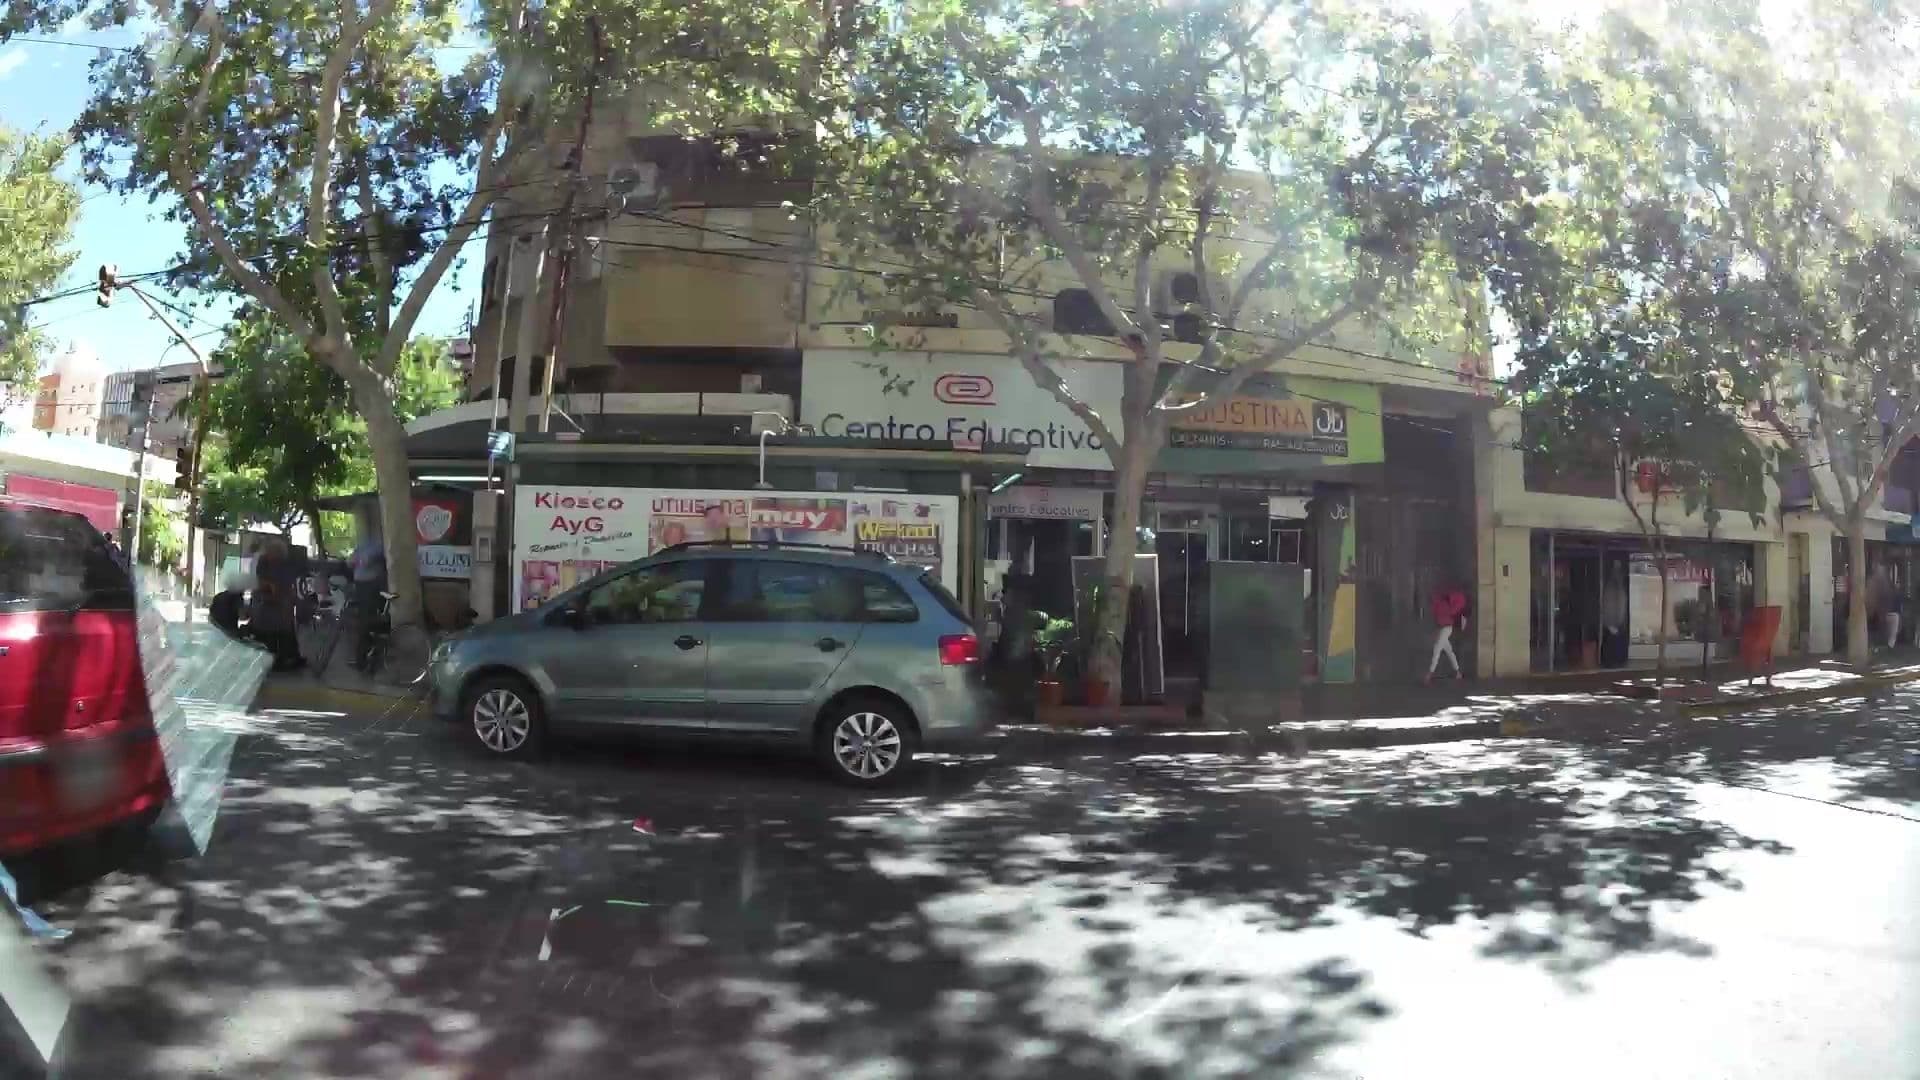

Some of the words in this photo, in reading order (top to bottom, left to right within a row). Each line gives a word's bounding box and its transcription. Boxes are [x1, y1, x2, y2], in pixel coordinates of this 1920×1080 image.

[821, 413, 935, 441] Centro
[947, 417, 1104, 450] Educativo
[535, 492, 624, 510] Kiosco
